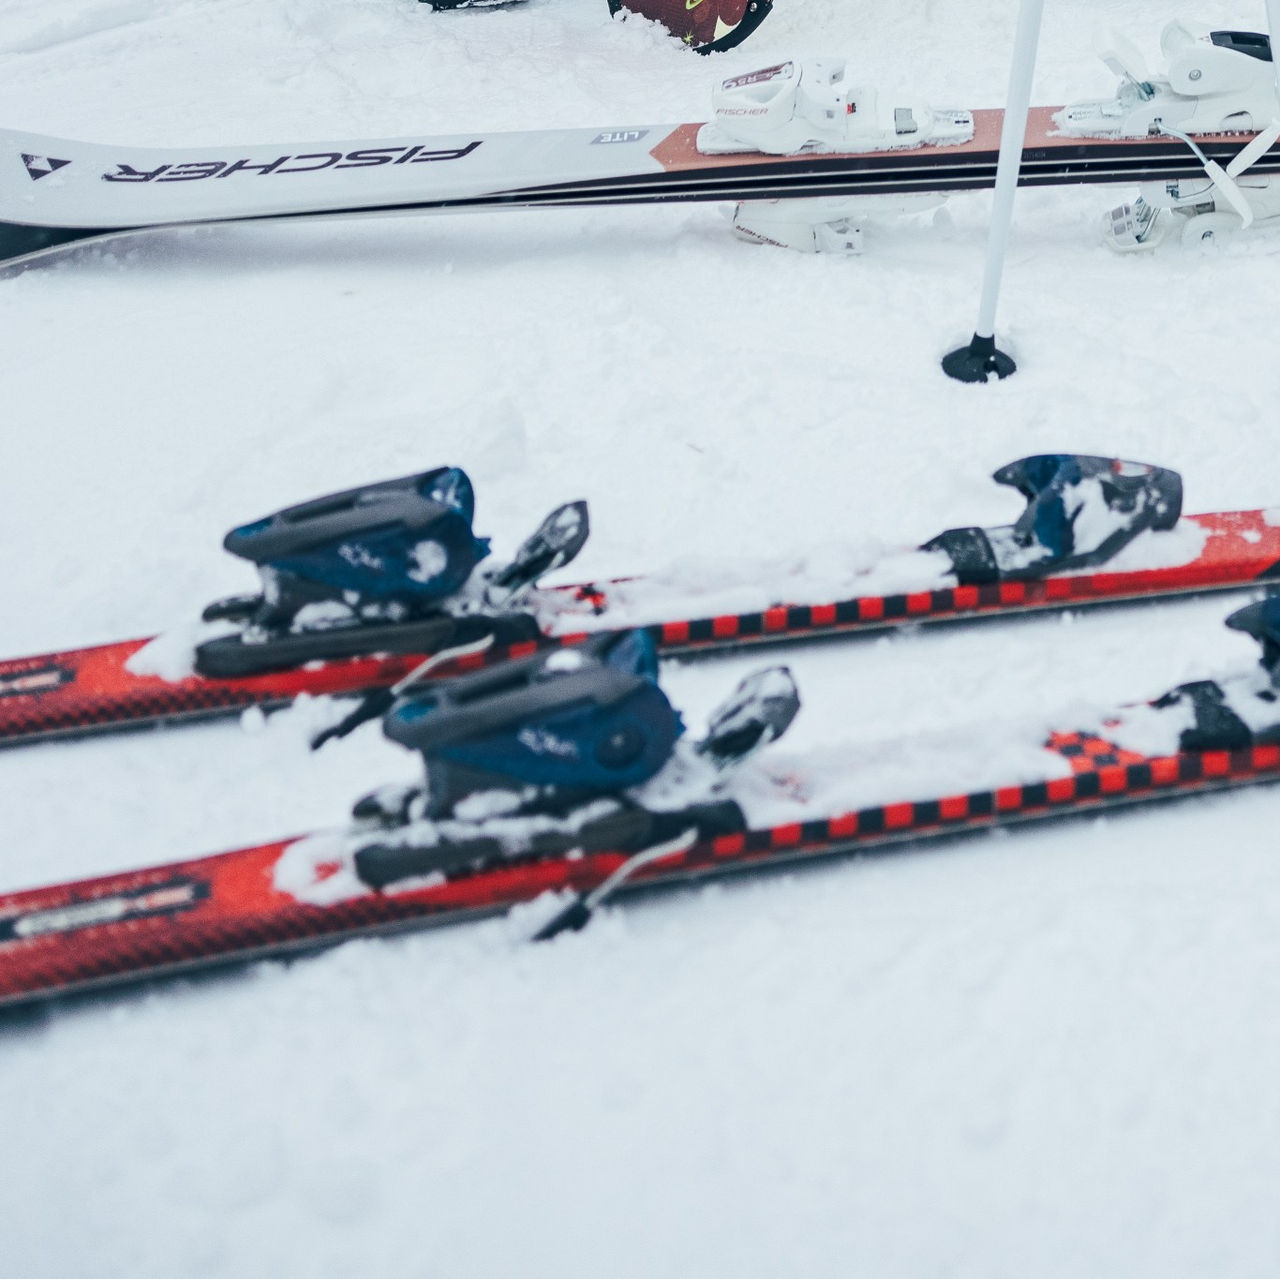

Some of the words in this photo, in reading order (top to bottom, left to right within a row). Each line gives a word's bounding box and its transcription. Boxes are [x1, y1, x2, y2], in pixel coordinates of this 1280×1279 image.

[715, 107, 769, 117] FISCHER
[600, 131, 640, 143] LITE
[100, 141, 484, 183] FISCHER
